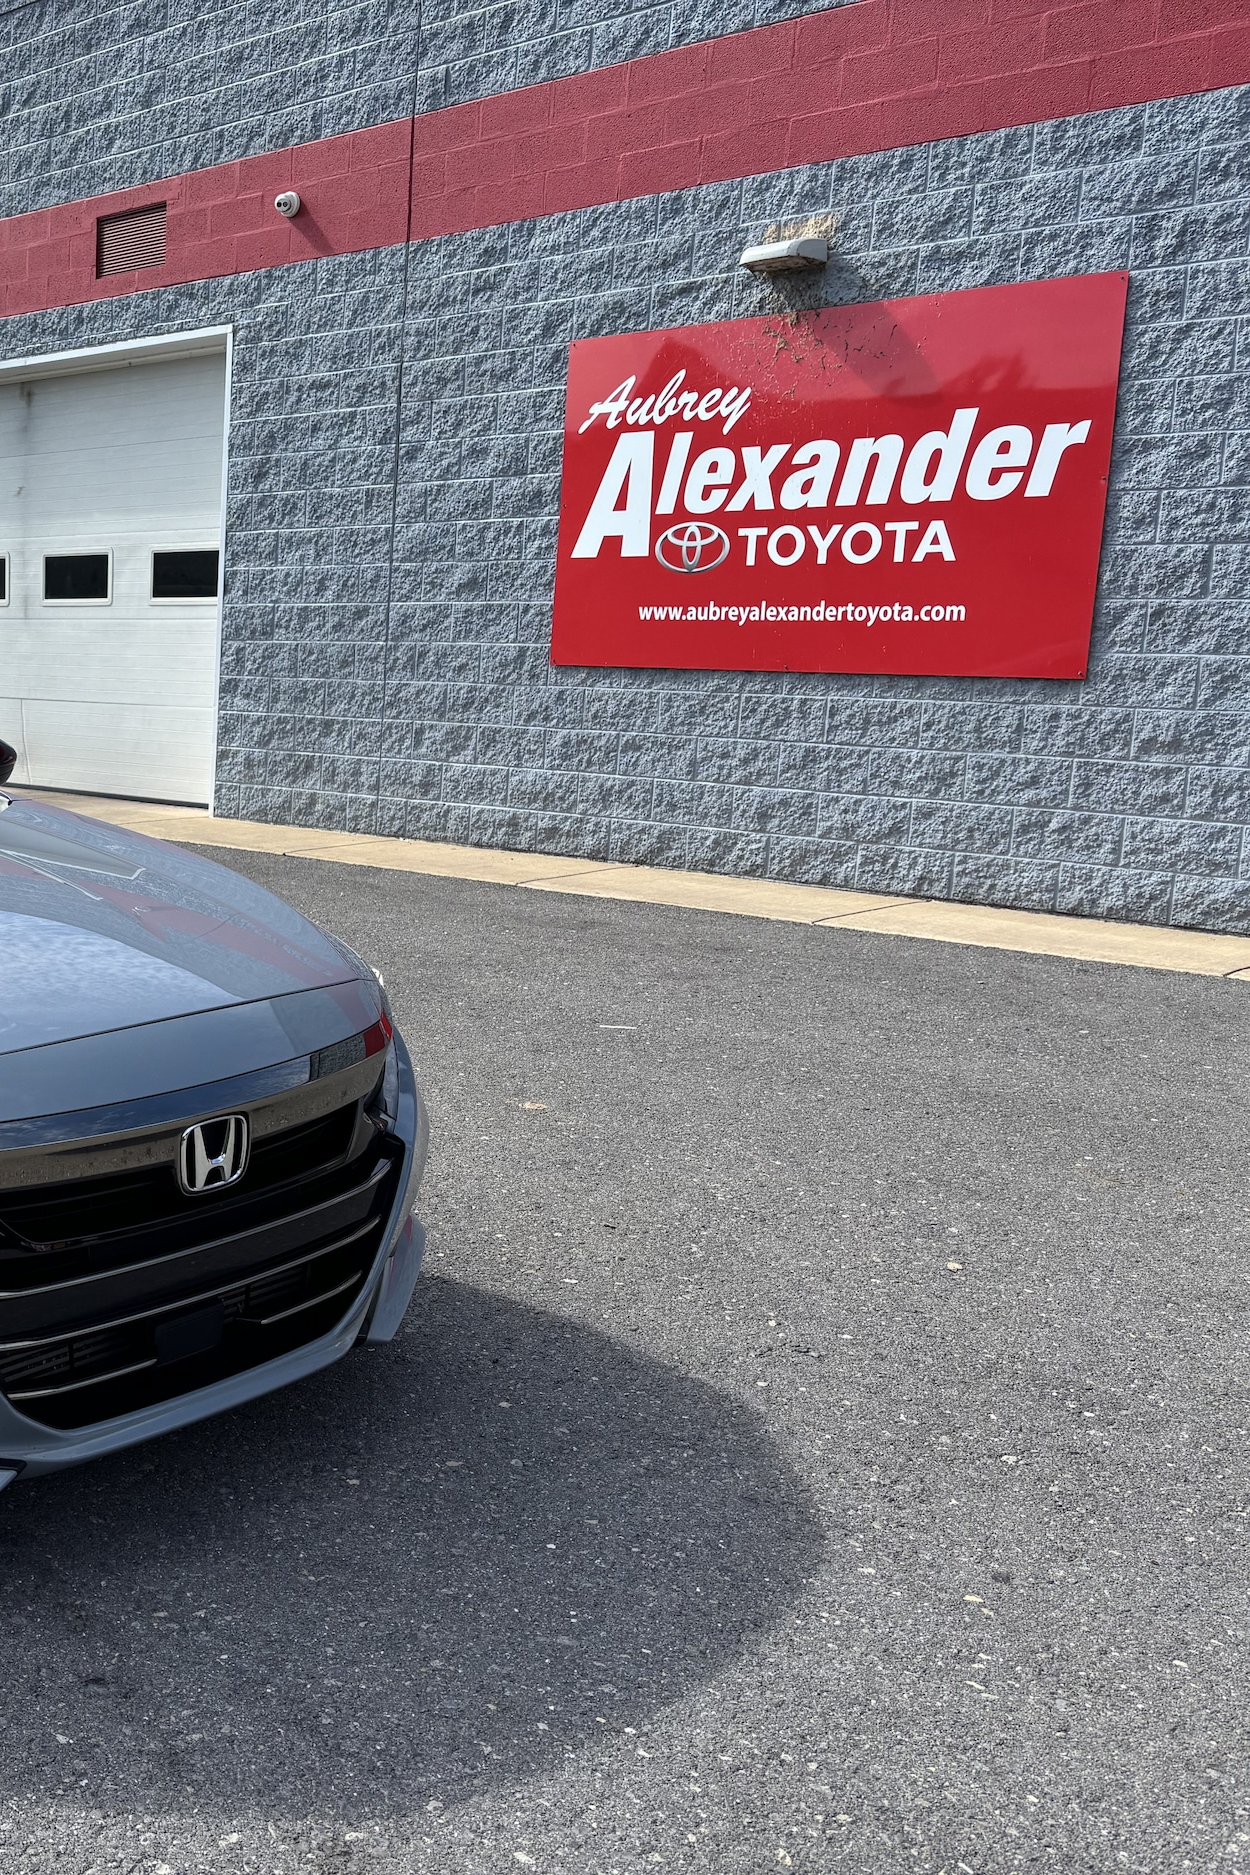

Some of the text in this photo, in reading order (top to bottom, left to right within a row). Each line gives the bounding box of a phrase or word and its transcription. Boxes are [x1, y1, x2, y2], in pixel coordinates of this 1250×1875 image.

[577, 368, 752, 436] Aubrey
[570, 407, 1092, 559] Alexander
[737, 520, 957, 567] TOYOTA
[638, 600, 966, 627] www.aubreyalexandertoyota.com
